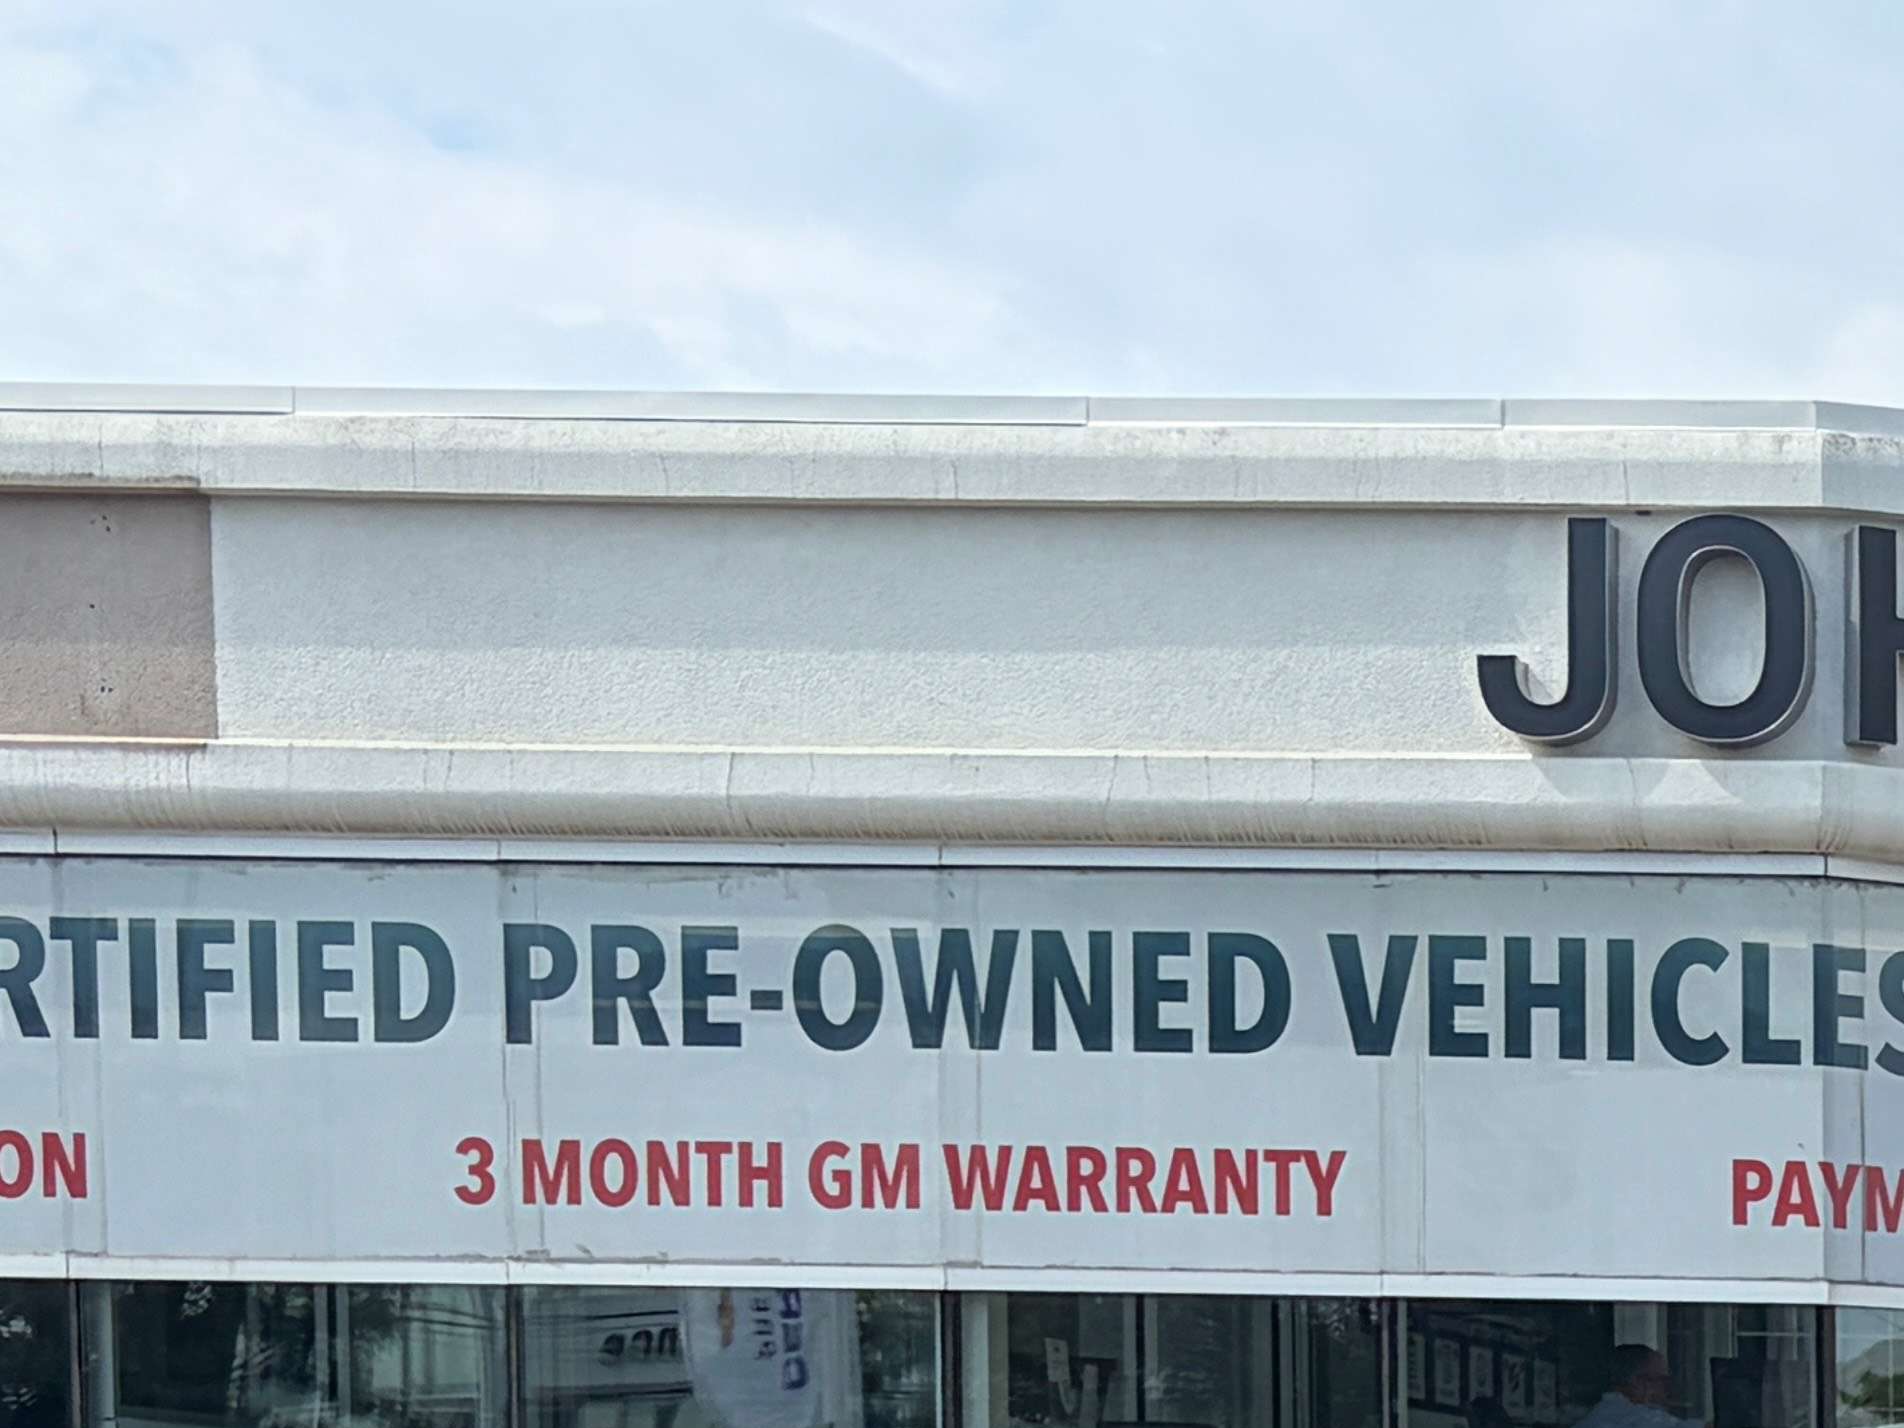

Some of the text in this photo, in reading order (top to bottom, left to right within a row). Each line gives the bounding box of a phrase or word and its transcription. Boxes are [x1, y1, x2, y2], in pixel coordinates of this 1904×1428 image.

[0, 916, 455, 1042] RTIFIED
[503, 922, 1292, 1053] PRE-OWNED
[0, 1130, 87, 1198] ON
[454, 1137, 1345, 1216] 3 MONTH GM WARRANTY
